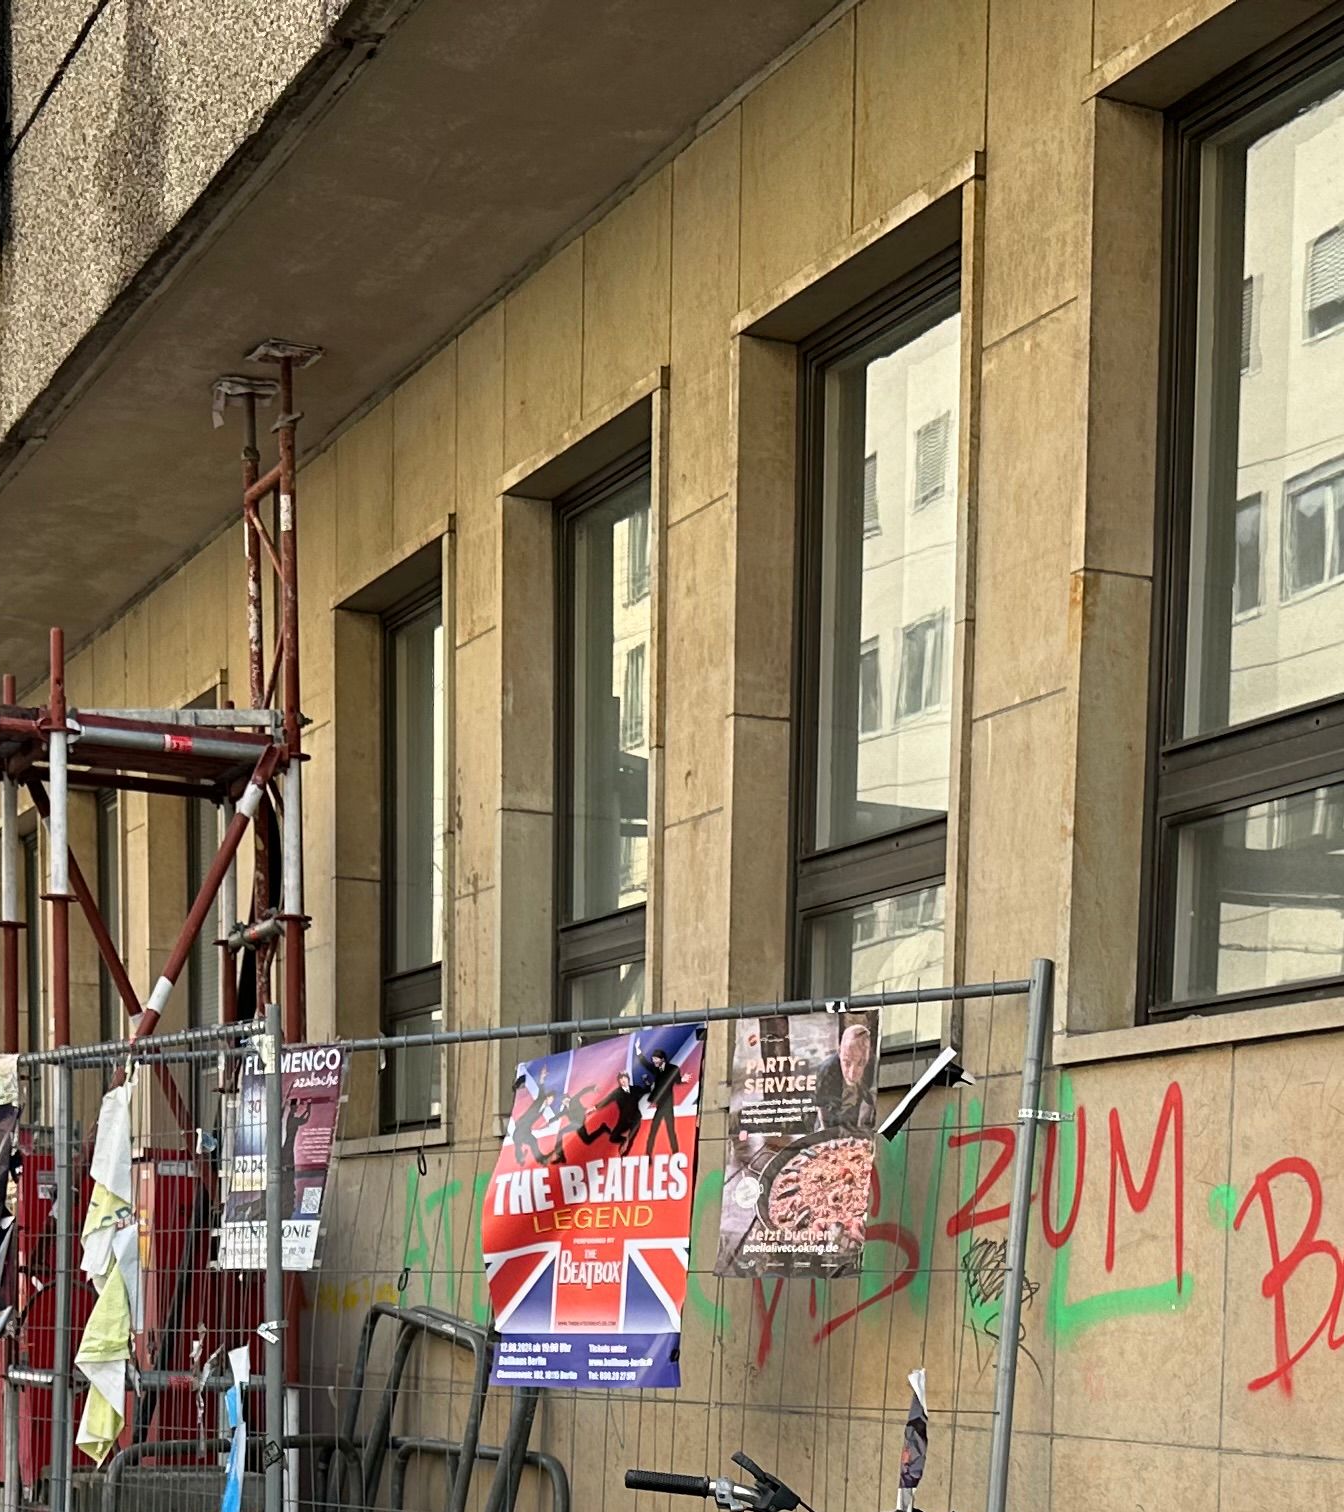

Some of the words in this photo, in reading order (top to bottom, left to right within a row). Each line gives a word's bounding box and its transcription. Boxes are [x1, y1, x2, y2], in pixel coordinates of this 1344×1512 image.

[244, 1048, 342, 1076] FLMENCO
[745, 1056, 806, 1075] PARTY-
[743, 1074, 817, 1095] SERVICE
[492, 1173, 556, 1216] THE
[559, 1151, 689, 1206] BEATLES
[532, 1205, 654, 1234] LEGEND
[746, 1228, 783, 1241] Jetzt
[584, 1248, 598, 1260] THE
[742, 1242, 839, 1255] paellalivecooking.de
[558, 1249, 623, 1290] BEATBOX
